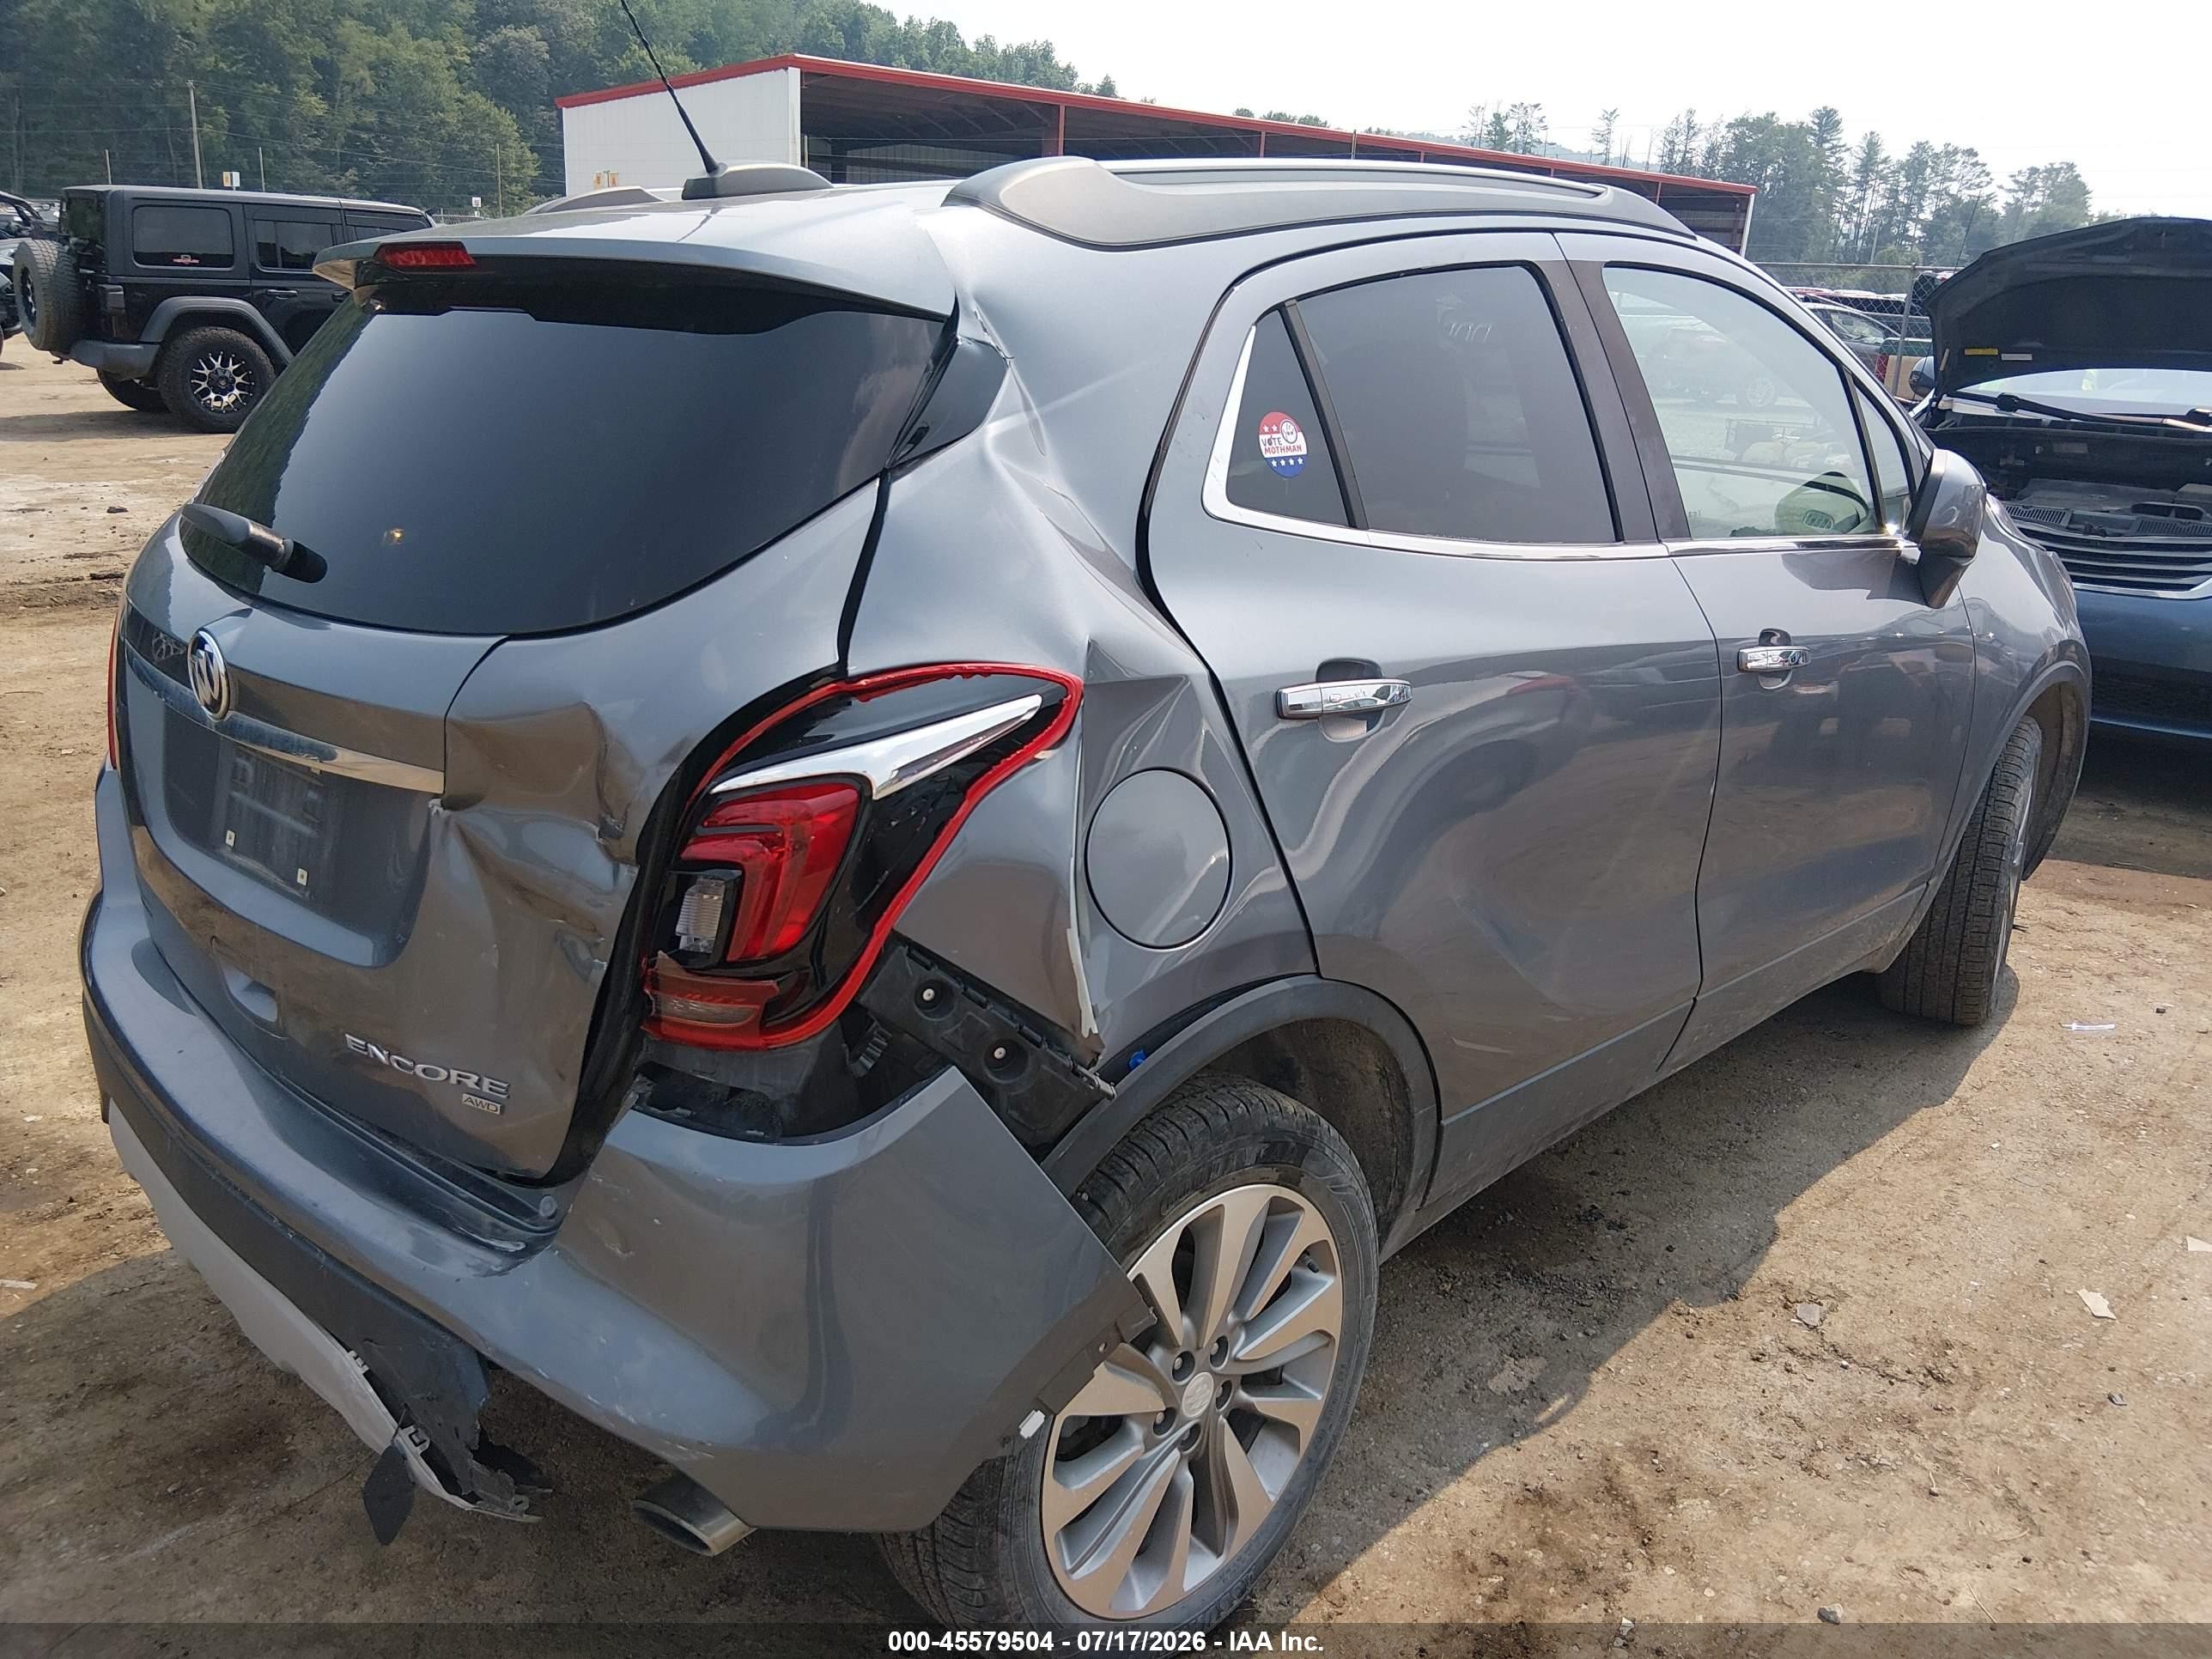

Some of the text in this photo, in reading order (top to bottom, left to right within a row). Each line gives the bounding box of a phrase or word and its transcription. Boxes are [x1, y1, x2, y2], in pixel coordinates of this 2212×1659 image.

[1261, 435, 1283, 447] VOTE
[1265, 445, 1303, 454] MOTHMAN
[345, 1033, 510, 1098] ENCORE
[464, 1096, 499, 1112] AWD
